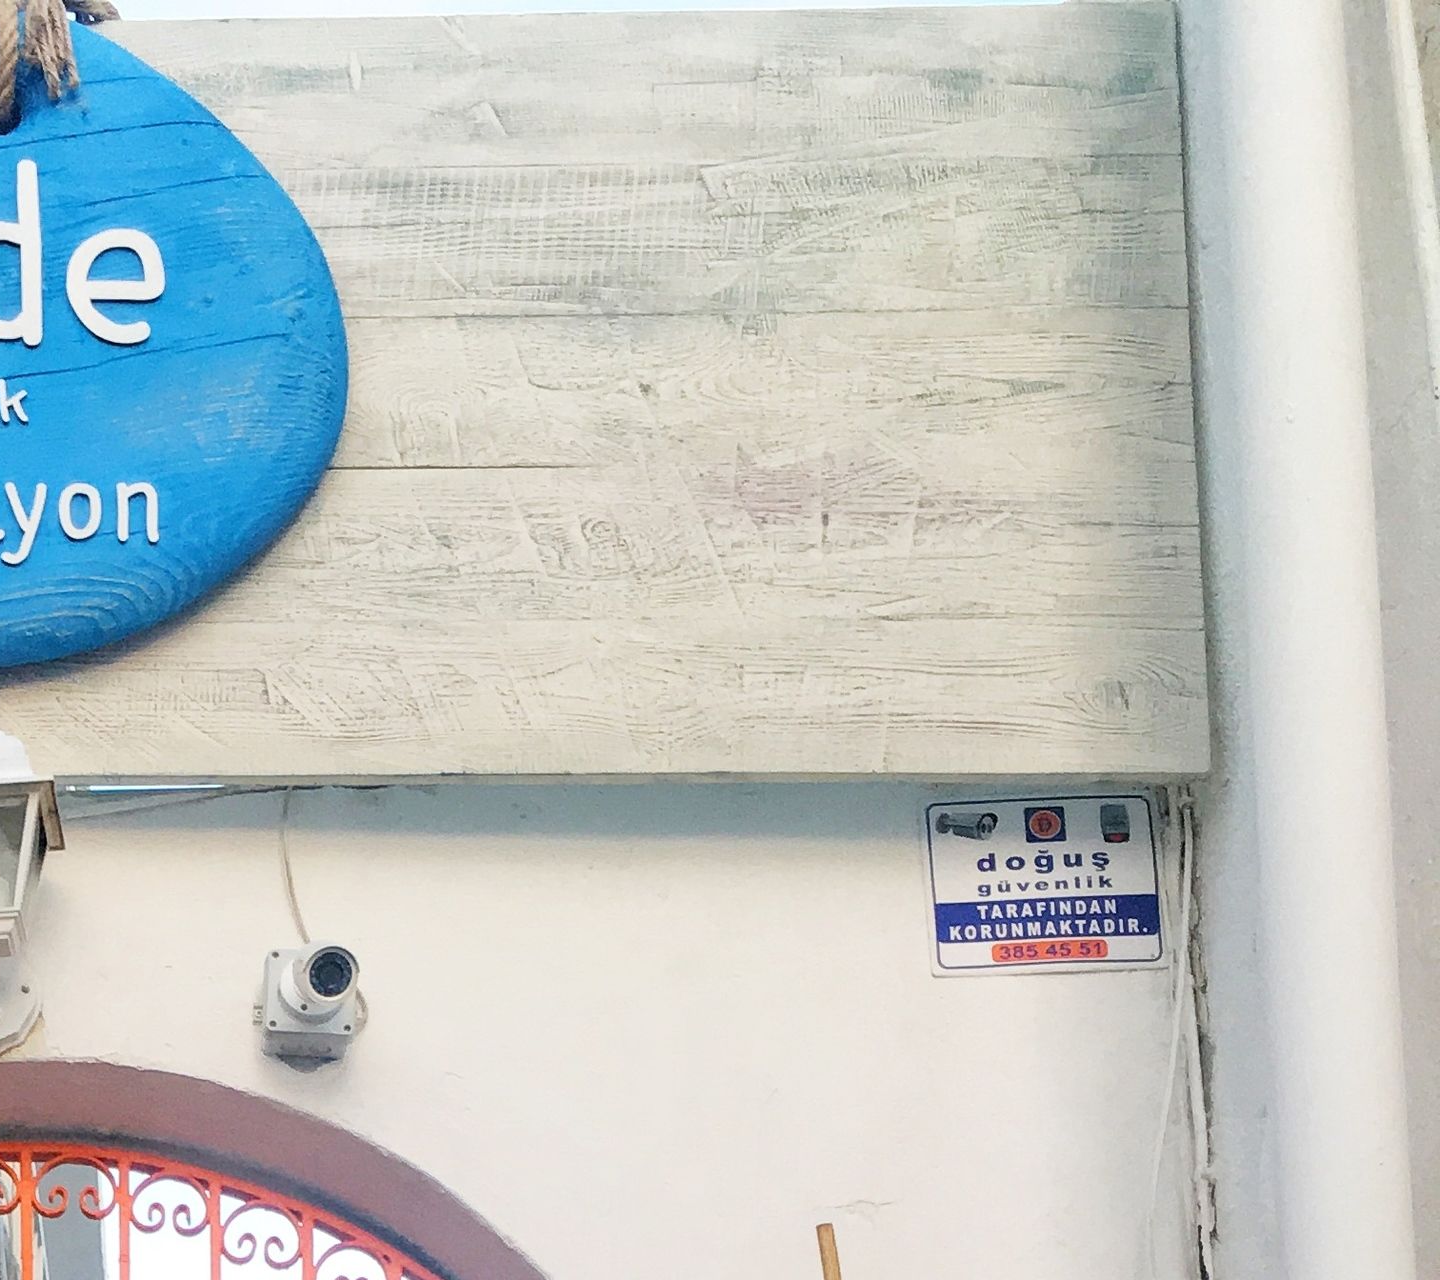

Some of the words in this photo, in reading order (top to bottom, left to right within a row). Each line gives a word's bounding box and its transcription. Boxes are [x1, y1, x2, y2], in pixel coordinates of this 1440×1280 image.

[976, 849, 1110, 874] doğuş
[977, 874, 1113, 897] güvenlik
[977, 898, 1117, 920] TARAFINDAN
[949, 917, 1148, 941] KORUNMAKTADIR.
[1000, 944, 1038, 960] 385
[1079, 941, 1101, 956] 51
